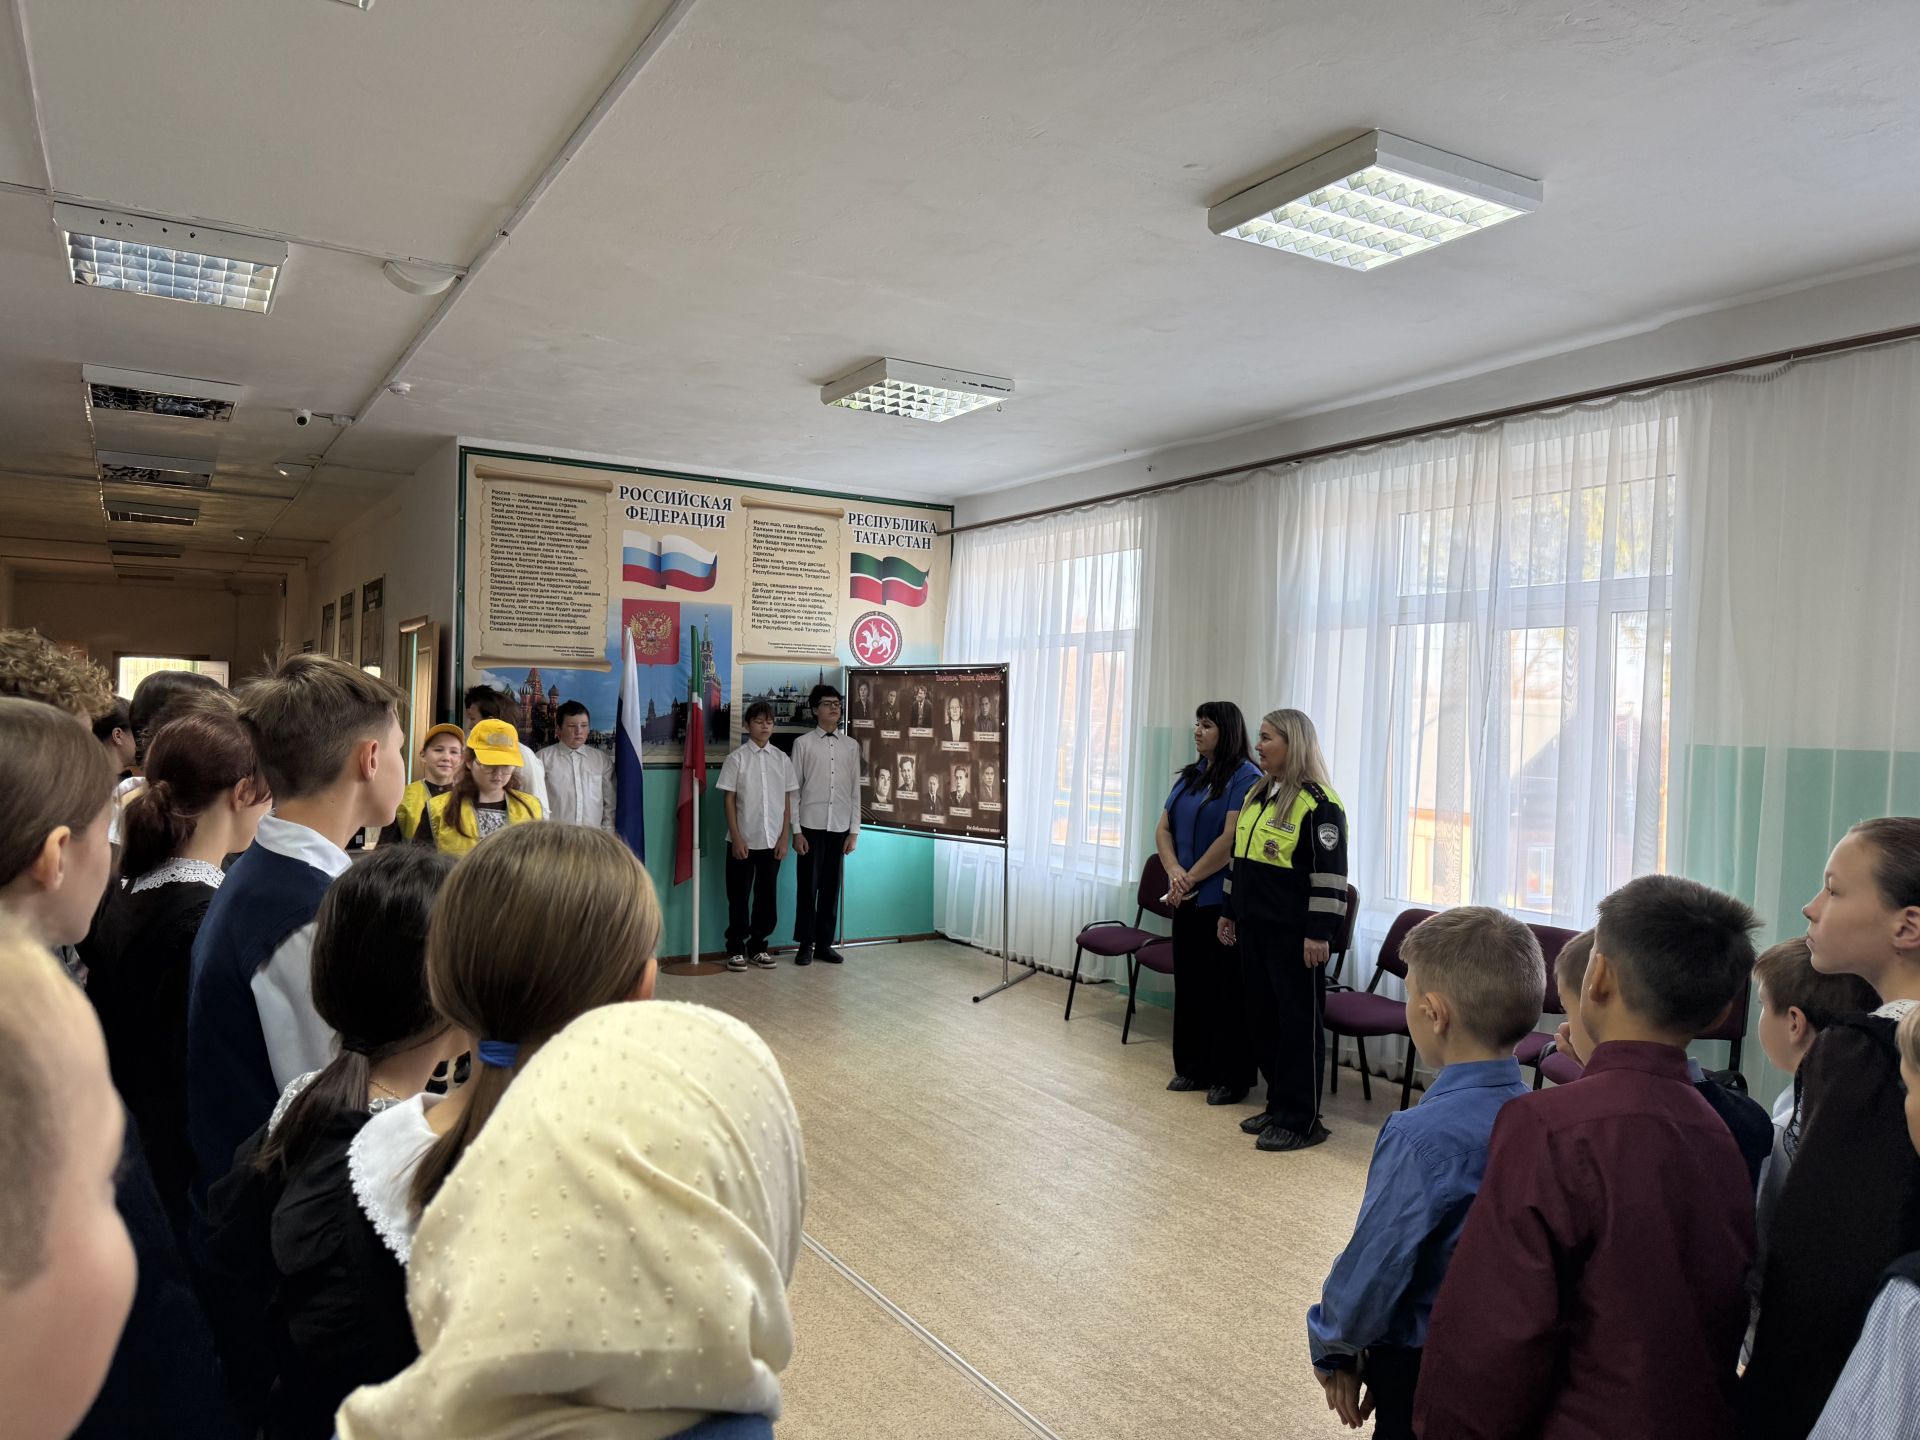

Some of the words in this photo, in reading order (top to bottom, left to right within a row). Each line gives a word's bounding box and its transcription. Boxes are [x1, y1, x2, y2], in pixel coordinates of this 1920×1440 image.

[619, 486, 732, 511] РОССИЙСКАЯ
[625, 505, 726, 529] ФЕДЕРАЦИЯ
[848, 512, 937, 534] РЕСПУБЛИКА
[854, 530, 931, 549] ТАТАРСТАН
